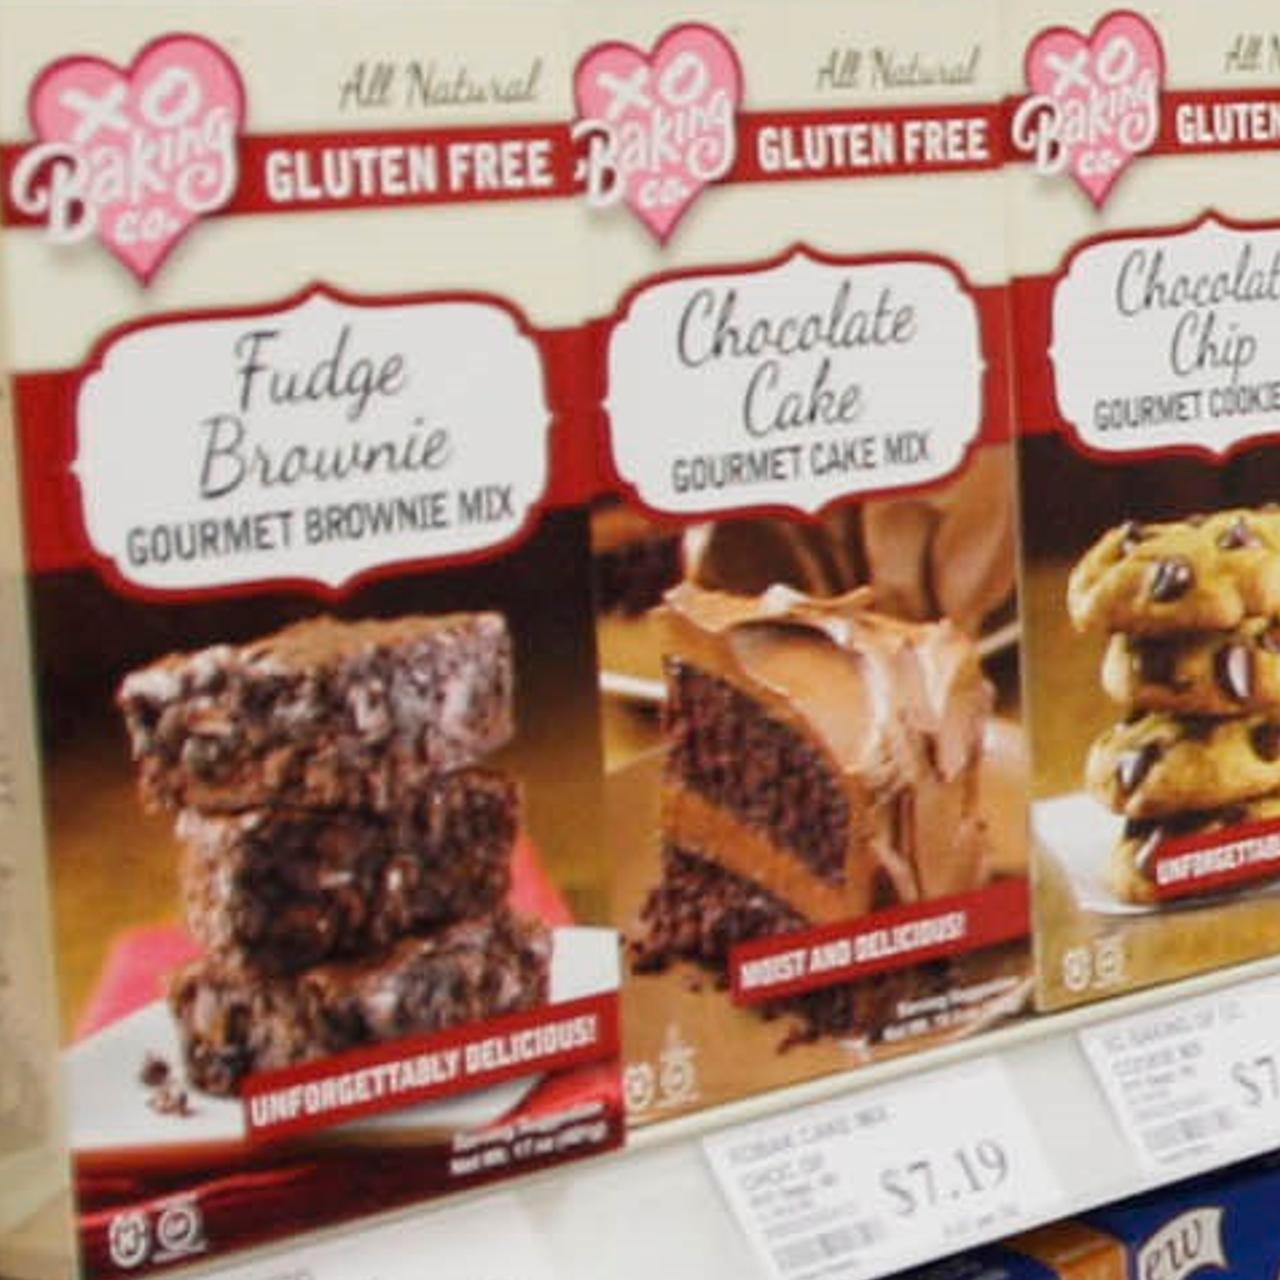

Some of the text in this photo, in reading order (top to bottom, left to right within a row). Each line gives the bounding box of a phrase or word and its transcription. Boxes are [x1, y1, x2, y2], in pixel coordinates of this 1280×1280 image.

[338, 57, 546, 109] All Natural
[595, 52, 708, 122] XO
[815, 45, 982, 91] All Natural
[1046, 37, 1137, 95] XO
[1223, 35, 1263, 74] All
[58, 66, 201, 141] XO
[1011, 65, 1160, 175] Baking
[8, 106, 241, 246] Baking
[264, 138, 555, 201] GLUTEN FREE
[570, 91, 737, 209] Baking
[756, 119, 990, 174] GLUTEN FREE
[676, 279, 917, 370] Chocolate
[1169, 310, 1258, 384] Chip
[234, 323, 408, 421] Fudge
[741, 357, 864, 439] Cake
[1093, 389, 1204, 433] GOURMET
[197, 417, 453, 501] Brownie
[672, 430, 931, 493] GOURMET CAKE MIX
[125, 484, 517, 567] GOURMET BROWNIE MIX
[808, 933, 852, 970] AND
[248, 1014, 599, 1127] UNFORGETTABLY DELICIOUS!
[877, 1138, 1011, 1218] $7.19
